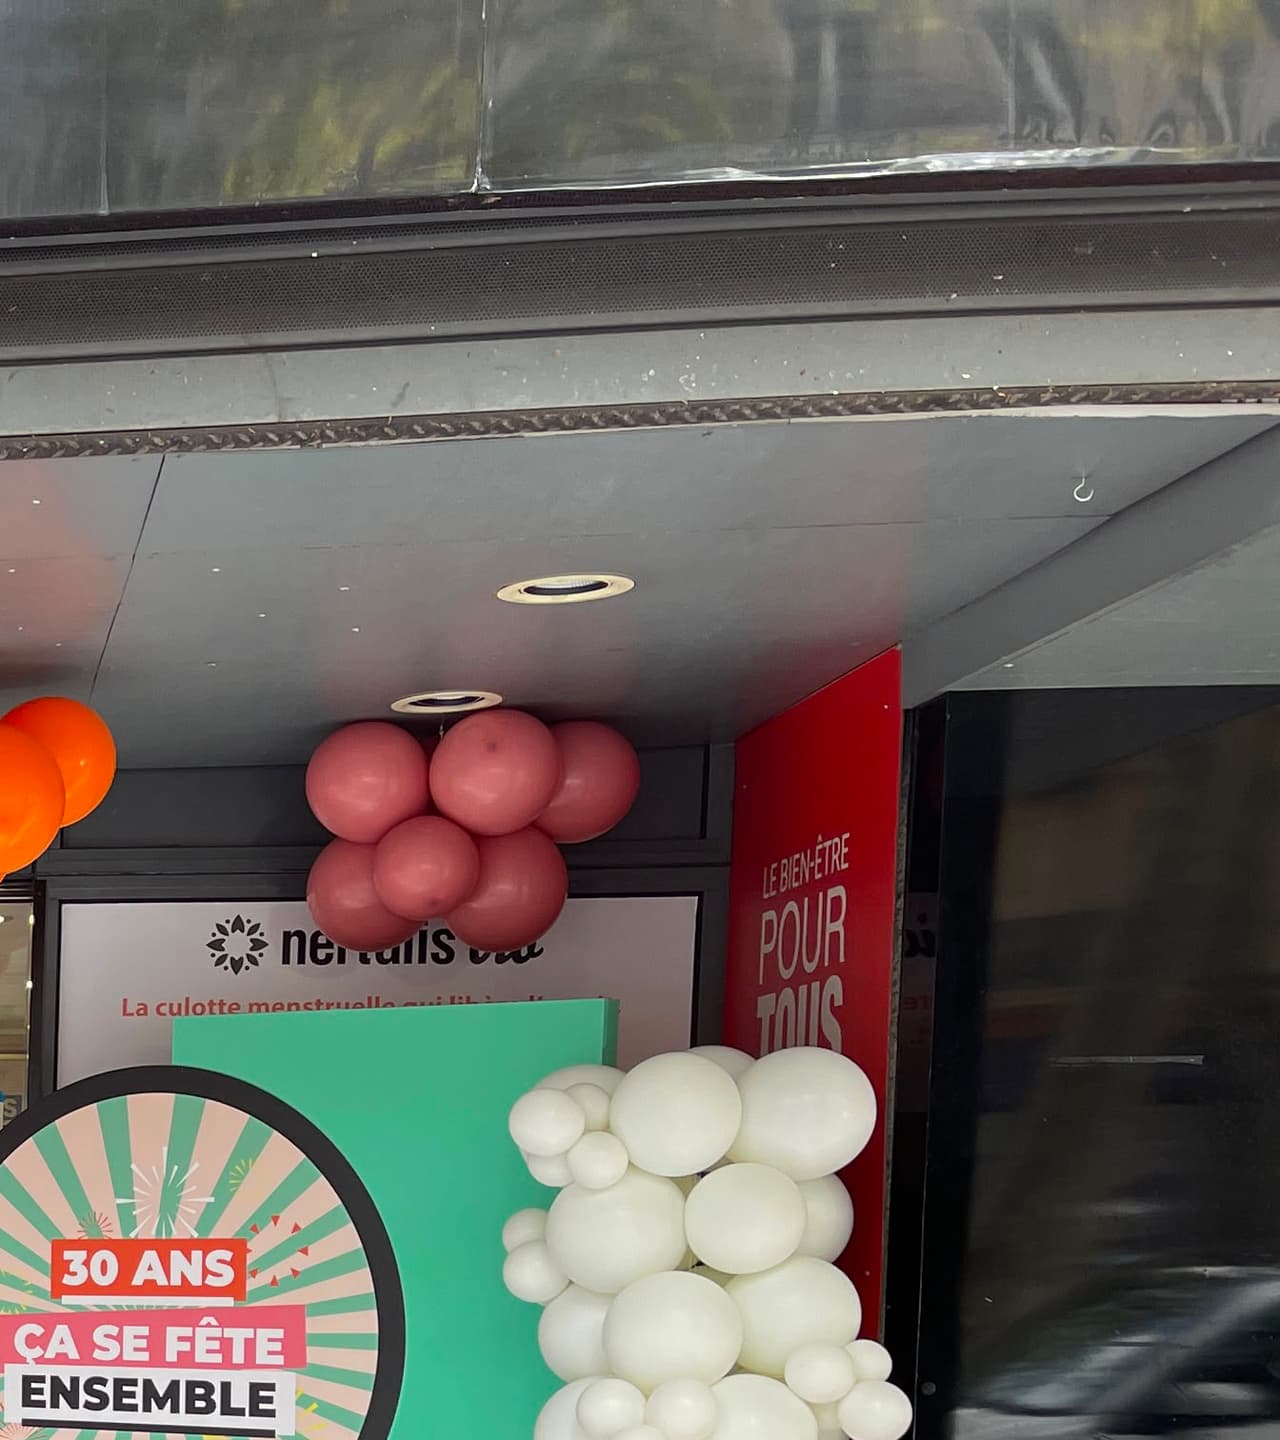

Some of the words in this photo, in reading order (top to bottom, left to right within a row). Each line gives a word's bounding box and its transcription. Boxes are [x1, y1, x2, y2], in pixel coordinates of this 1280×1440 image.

[762, 862, 778, 899] LE
[779, 832, 850, 894] BIEN-ÊTRE
[760, 885, 847, 985] POUR
[121, 998, 149, 1017] La
[155, 996, 241, 1018] culotte
[757, 974, 843, 1058] TOUS
[61, 1249, 118, 1287] 30
[131, 1249, 235, 1287] ANS
[14, 1323, 80, 1366] ÇA
[92, 1323, 150, 1362] SE
[165, 1316, 285, 1366] FÊTE
[21, 1374, 277, 1419] ENSEMBLE
